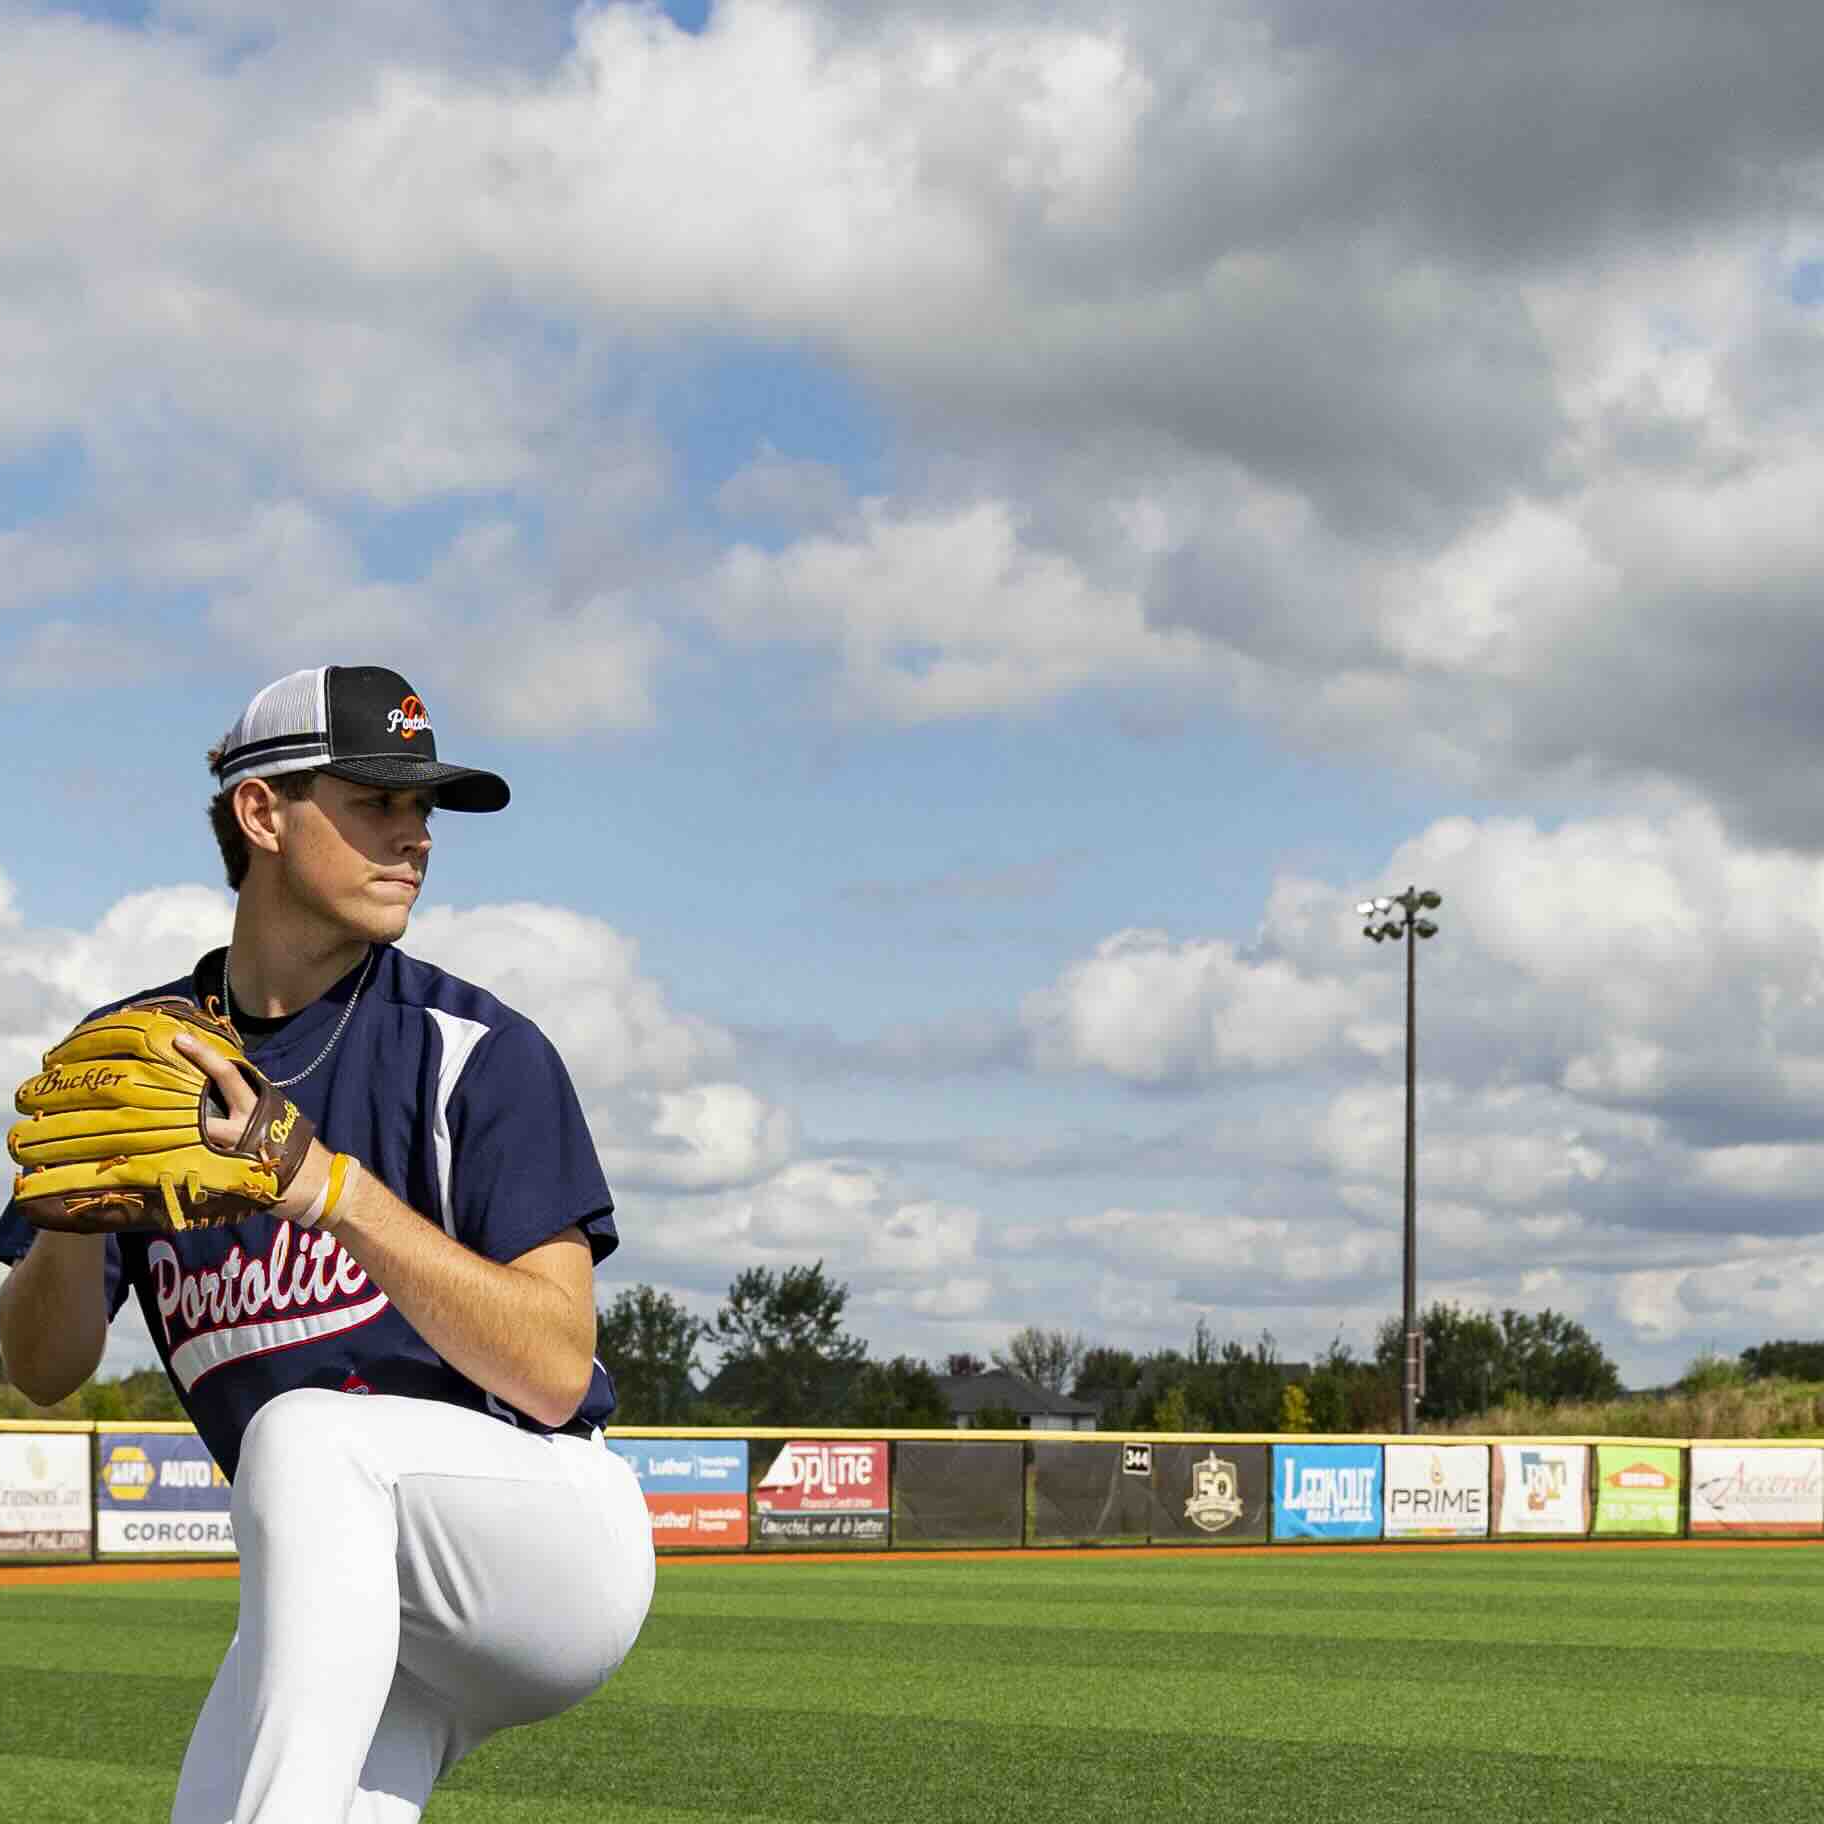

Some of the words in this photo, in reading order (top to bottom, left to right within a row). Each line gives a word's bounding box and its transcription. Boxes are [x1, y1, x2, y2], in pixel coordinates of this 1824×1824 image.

[35, 1066, 128, 1096] Buckler
[147, 1219, 368, 1346] Portolite
[789, 1447, 876, 1495] opline
[1125, 1449, 1149, 1467] 344
[159, 1460, 212, 1488] AUTO
[1199, 1471, 1232, 1500] 50
[1391, 1488, 1481, 1514] PRIME
[124, 1522, 234, 1542] CORCORA
